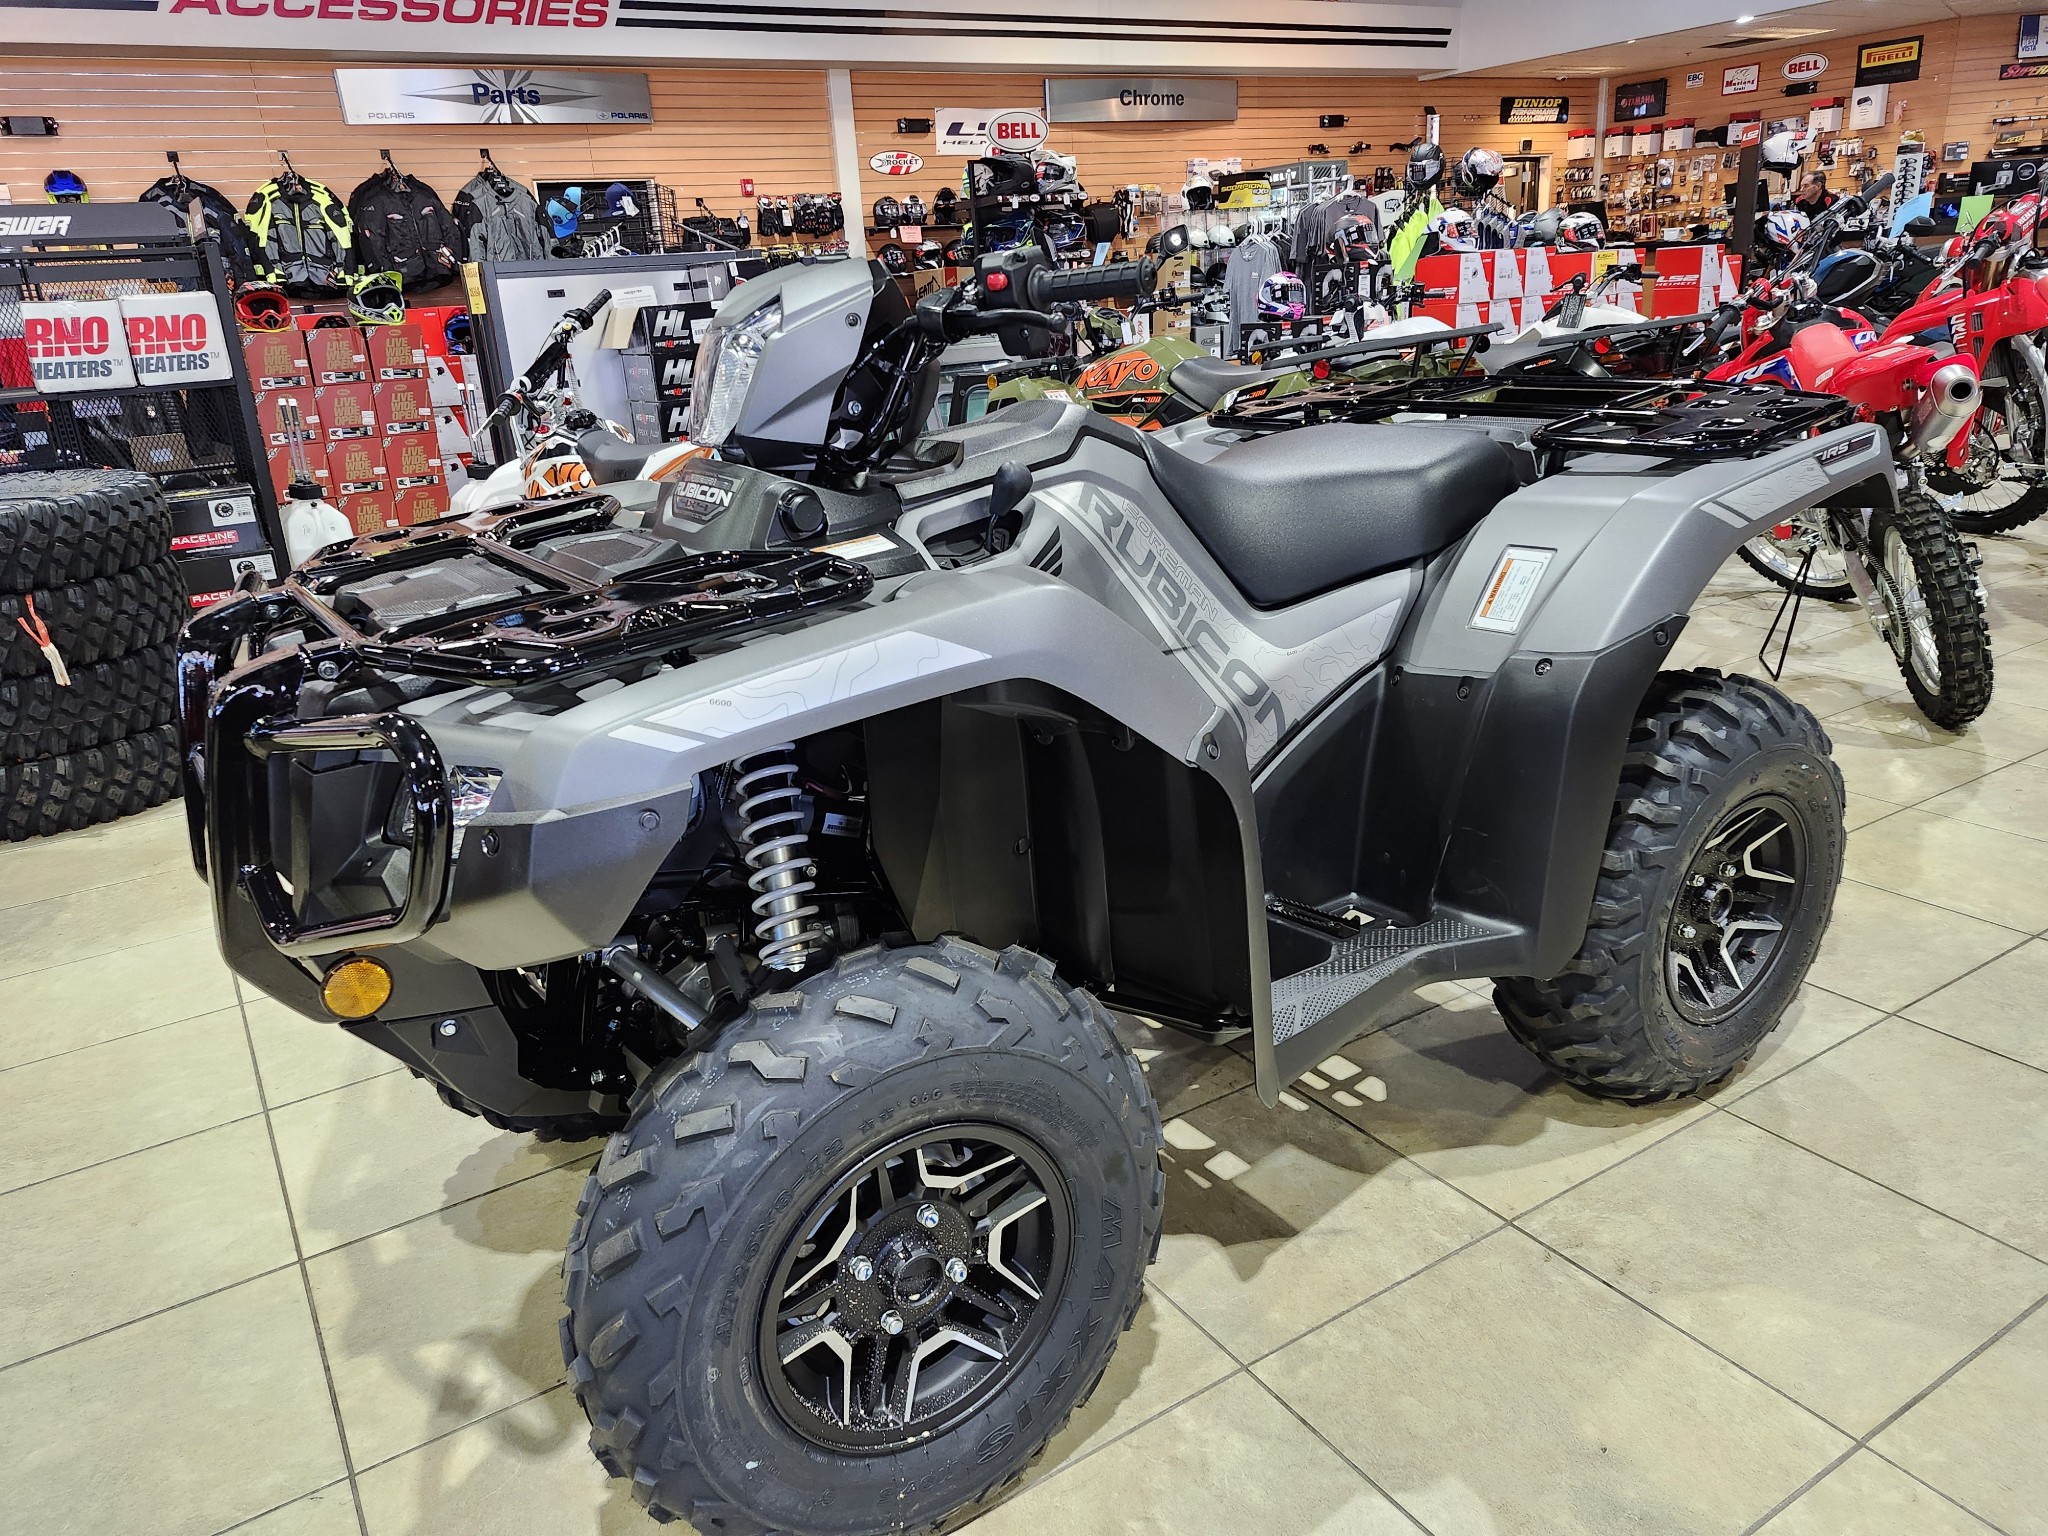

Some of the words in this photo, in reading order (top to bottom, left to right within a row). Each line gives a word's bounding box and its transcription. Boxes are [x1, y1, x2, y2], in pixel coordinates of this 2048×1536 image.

[169, 0, 607, 27] ACCESSORIES
[1866, 46, 1914, 64] PIRELLI
[1788, 60, 1820, 73] BELL
[1688, 73, 1703, 81] EBC
[472, 82, 541, 106] Parts
[1120, 89, 1184, 106] Chrome
[1628, 95, 1655, 107] YAMAHA
[1513, 99, 1562, 108] DUNLOP
[611, 112, 648, 120] POLARIS
[997, 122, 1041, 139] BELL
[1742, 129, 1759, 141] LS2
[886, 158, 919, 166] ROCKET
[1221, 183, 1263, 192] SCORPION
[1656, 274, 1699, 283] LS2
[653, 310, 689, 337] HL
[25, 316, 109, 358] RNO
[386, 338, 408, 347] LIVE
[386, 347, 412, 357] WIDE
[33, 359, 113, 380] HEATERS
[135, 352, 210, 374] HEATERS
[1076, 351, 1159, 391] KAYO
[662, 359, 694, 385] HL
[334, 398, 357, 407] LIVE
[334, 406, 360, 416] WIDE
[668, 407, 690, 433] H
[1821, 441, 1849, 461] IRS
[675, 482, 733, 507] RUBICON
[357, 505, 379, 515] LIVE
[357, 514, 383, 524] WIDE
[171, 531, 237, 546] RACELINE
[1122, 498, 1219, 622] FOREMAN
[1077, 482, 1300, 737] RUBICON
[709, 698, 732, 707] 6600
[977, 1195, 1122, 1465] MAXXIS
